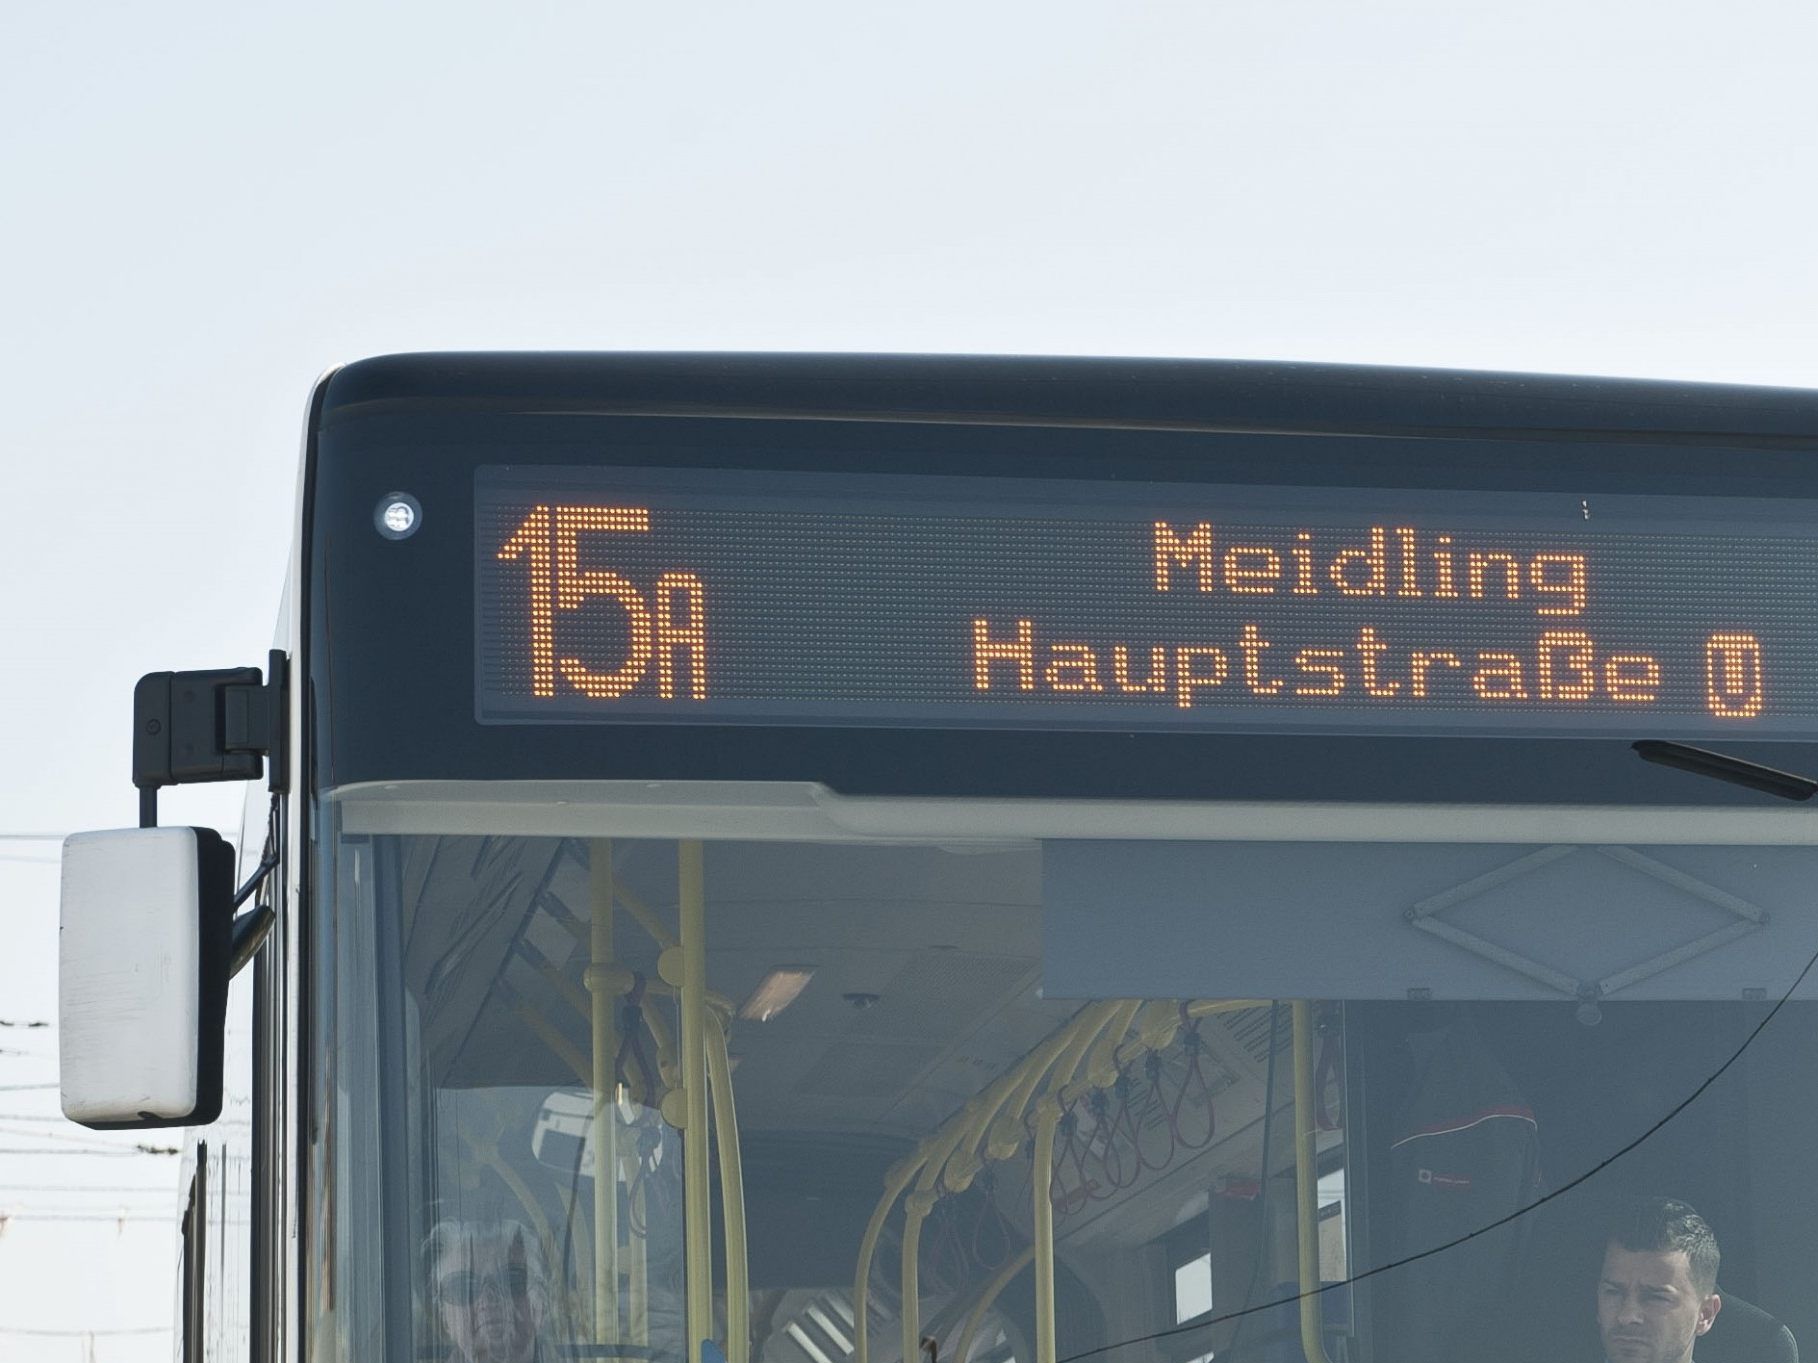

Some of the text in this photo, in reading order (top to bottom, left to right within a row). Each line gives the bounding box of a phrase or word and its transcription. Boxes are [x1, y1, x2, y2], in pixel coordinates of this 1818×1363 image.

[498, 505, 706, 700] 15A
[1153, 519, 1588, 616] Meidling
[972, 617, 1661, 709] Hauptstraße
